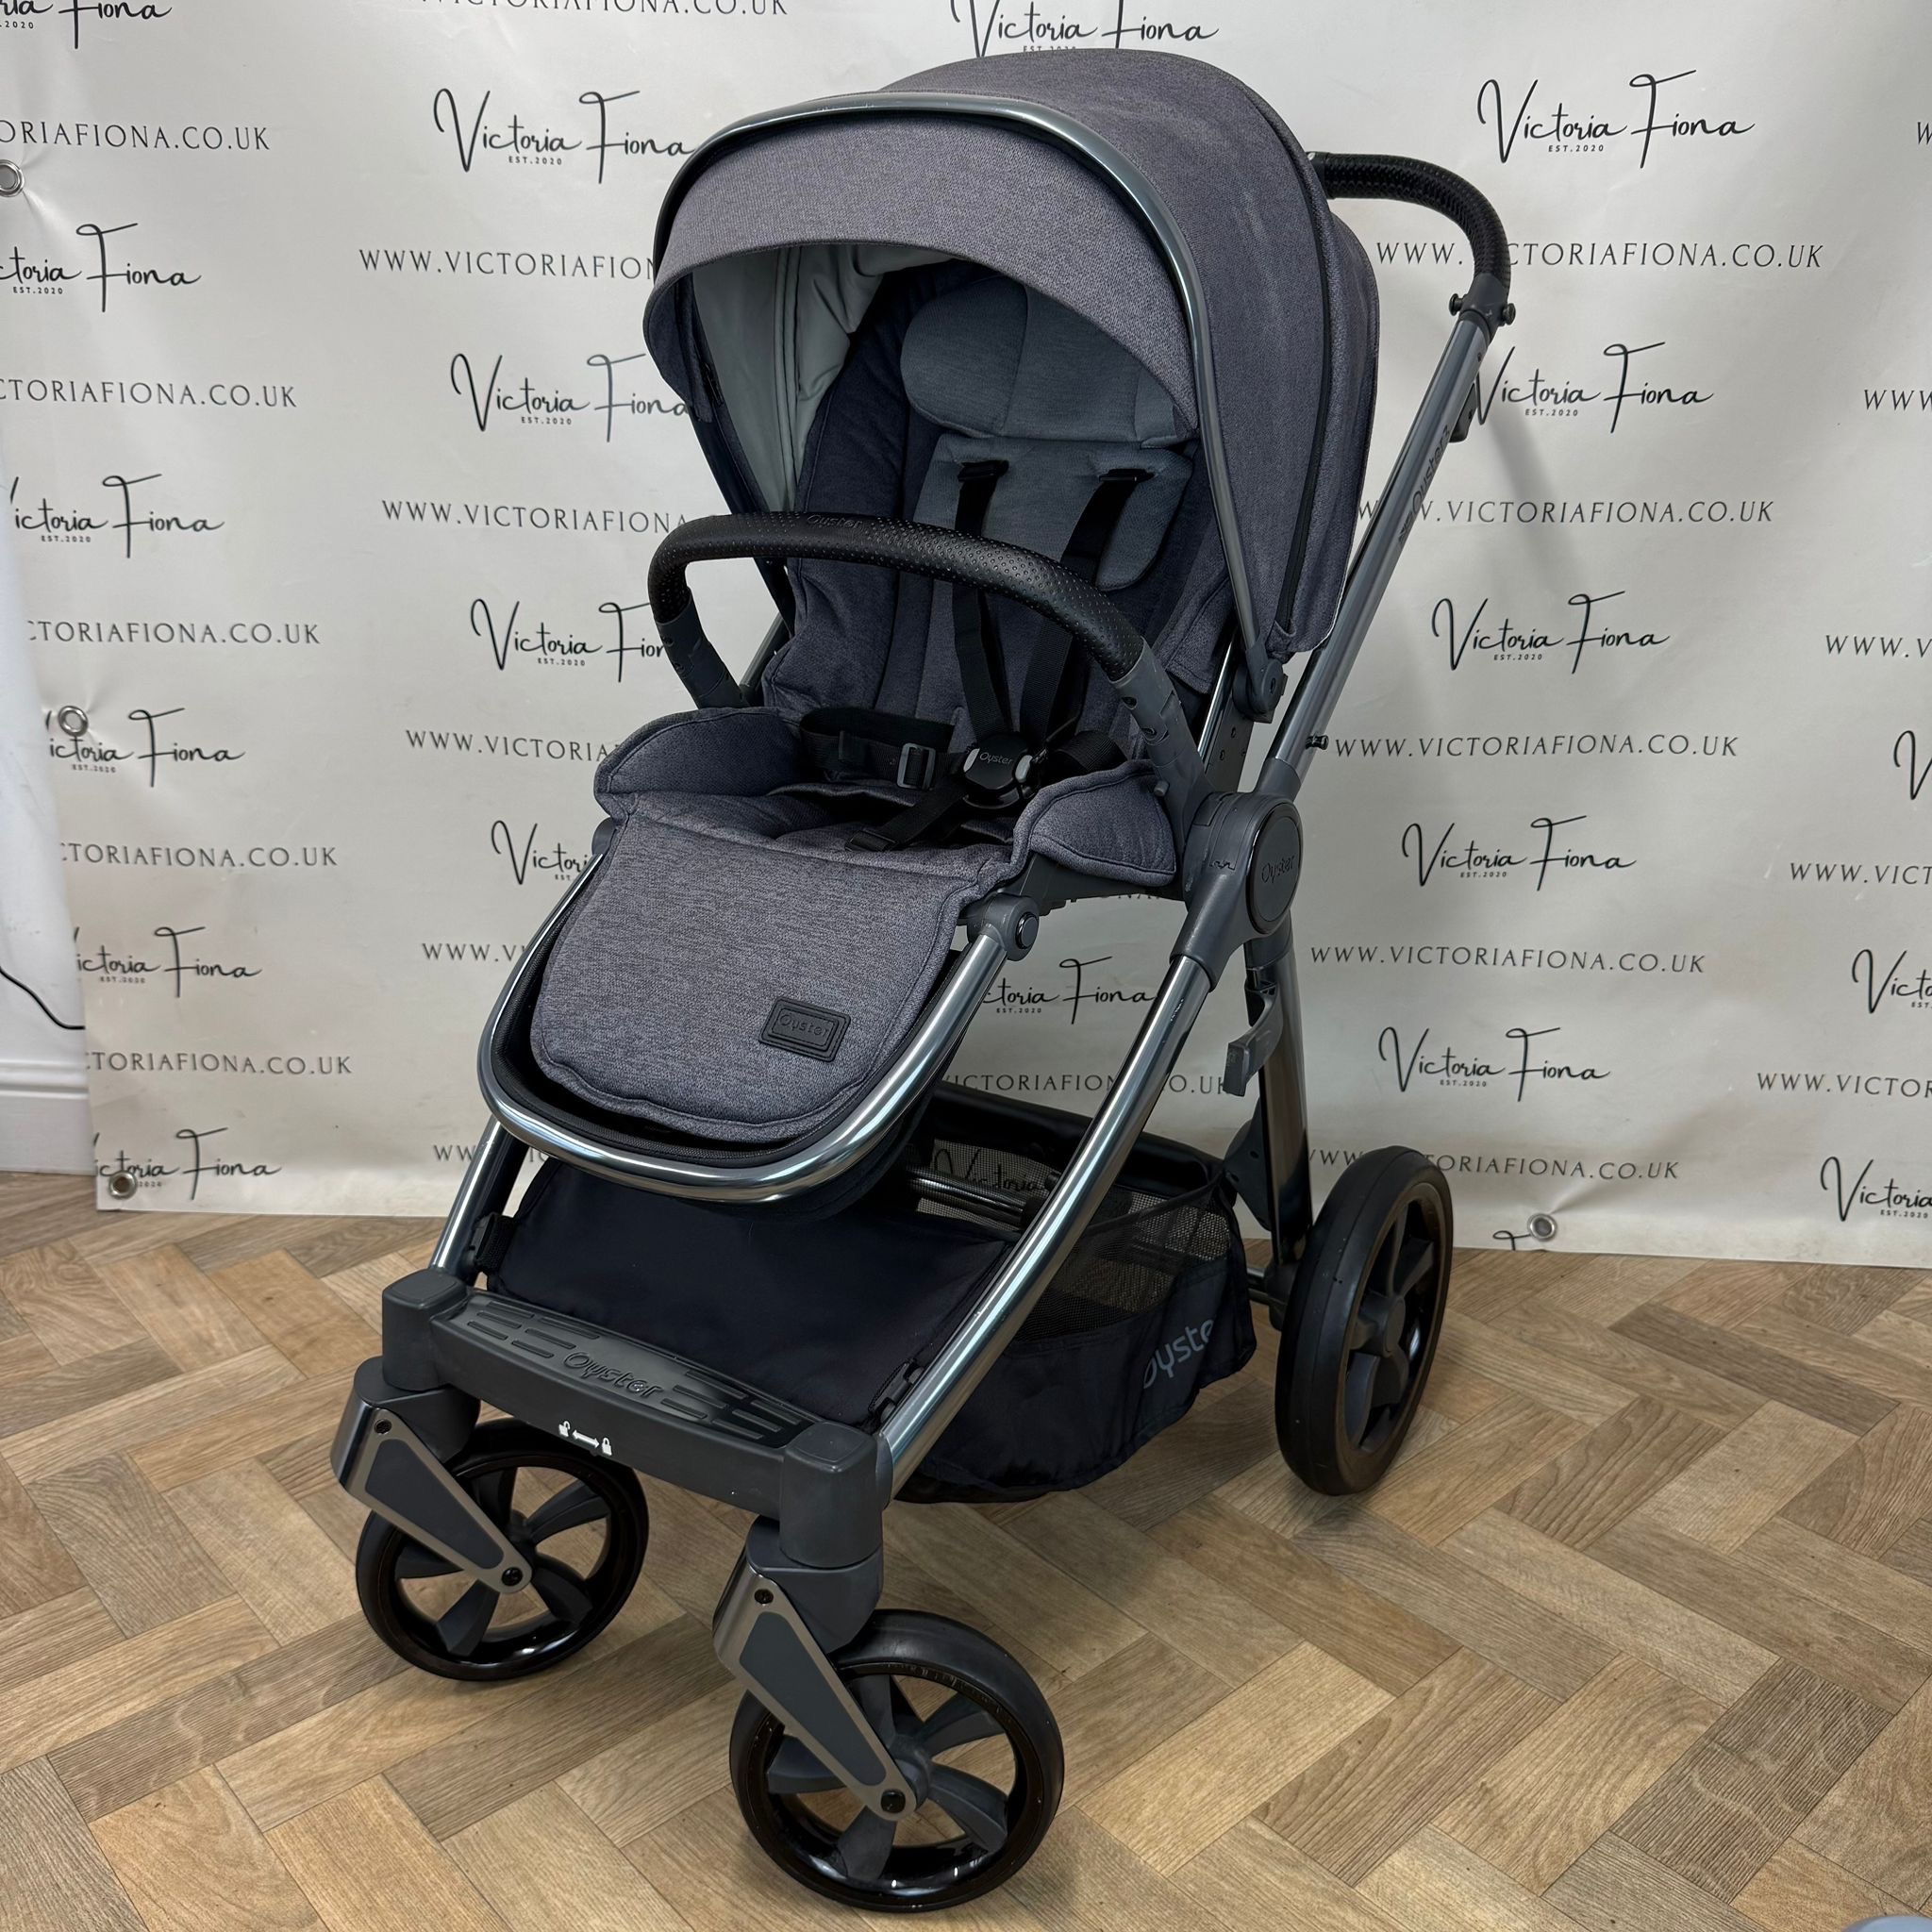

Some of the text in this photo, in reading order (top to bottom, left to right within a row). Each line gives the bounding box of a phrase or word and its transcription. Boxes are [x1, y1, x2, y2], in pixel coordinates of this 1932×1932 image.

[0, 21, 34, 29] .2020
[0, 120, 270, 150] ORIAFIONA.CO.UK
[434, 88, 695, 184] Victoria Fiona
[1477, 70, 1756, 169] Victoria Fiona
[508, 156, 562, 165] EST.2020
[1548, 144, 1604, 153] EST.2020
[0, 223, 202, 312] toria Fiona
[13, 286, 63, 294] EST.2020
[0, 379, 297, 408] TORIAFIONA.CO.UK
[451, 353, 591, 432] Victoria
[1477, 341, 1715, 433] Victoria Fiona
[522, 416, 573, 425] EST.2020
[1524, 408, 1579, 417] EST.2020
[10, 474, 225, 558] ictoria Fiona
[28, 621, 320, 644] TORIAFIONA.CO.UK
[472, 598, 603, 671] Victoria
[1432, 591, 1670, 674] Victoria Fiona
[46, 708, 245, 787] ictoria Fiona
[979, 752, 1013, 764] Oyster
[1335, 735, 1739, 758] WWW.VICTORIAFIONA.CO.UK
[61, 842, 337, 867] TORIAFIONA.CO.UK
[1402, 815, 1637, 891] Victoria Fiona
[74, 926, 262, 998] ictoria Fiona
[1310, 946, 1706, 973] WWW.VICTORIAFIONA.CO.UK
[1059, 956, 1157, 1024] Fiona
[779, 1014, 829, 1038] Oyster
[86, 1051, 352, 1074] TORIAFIONA.CO.UK
[1378, 1026, 1610, 1102] Victoria Fiona
[93, 1127, 282, 1200] ictoria Fiona
[563, 1352, 664, 1398] Oyster
